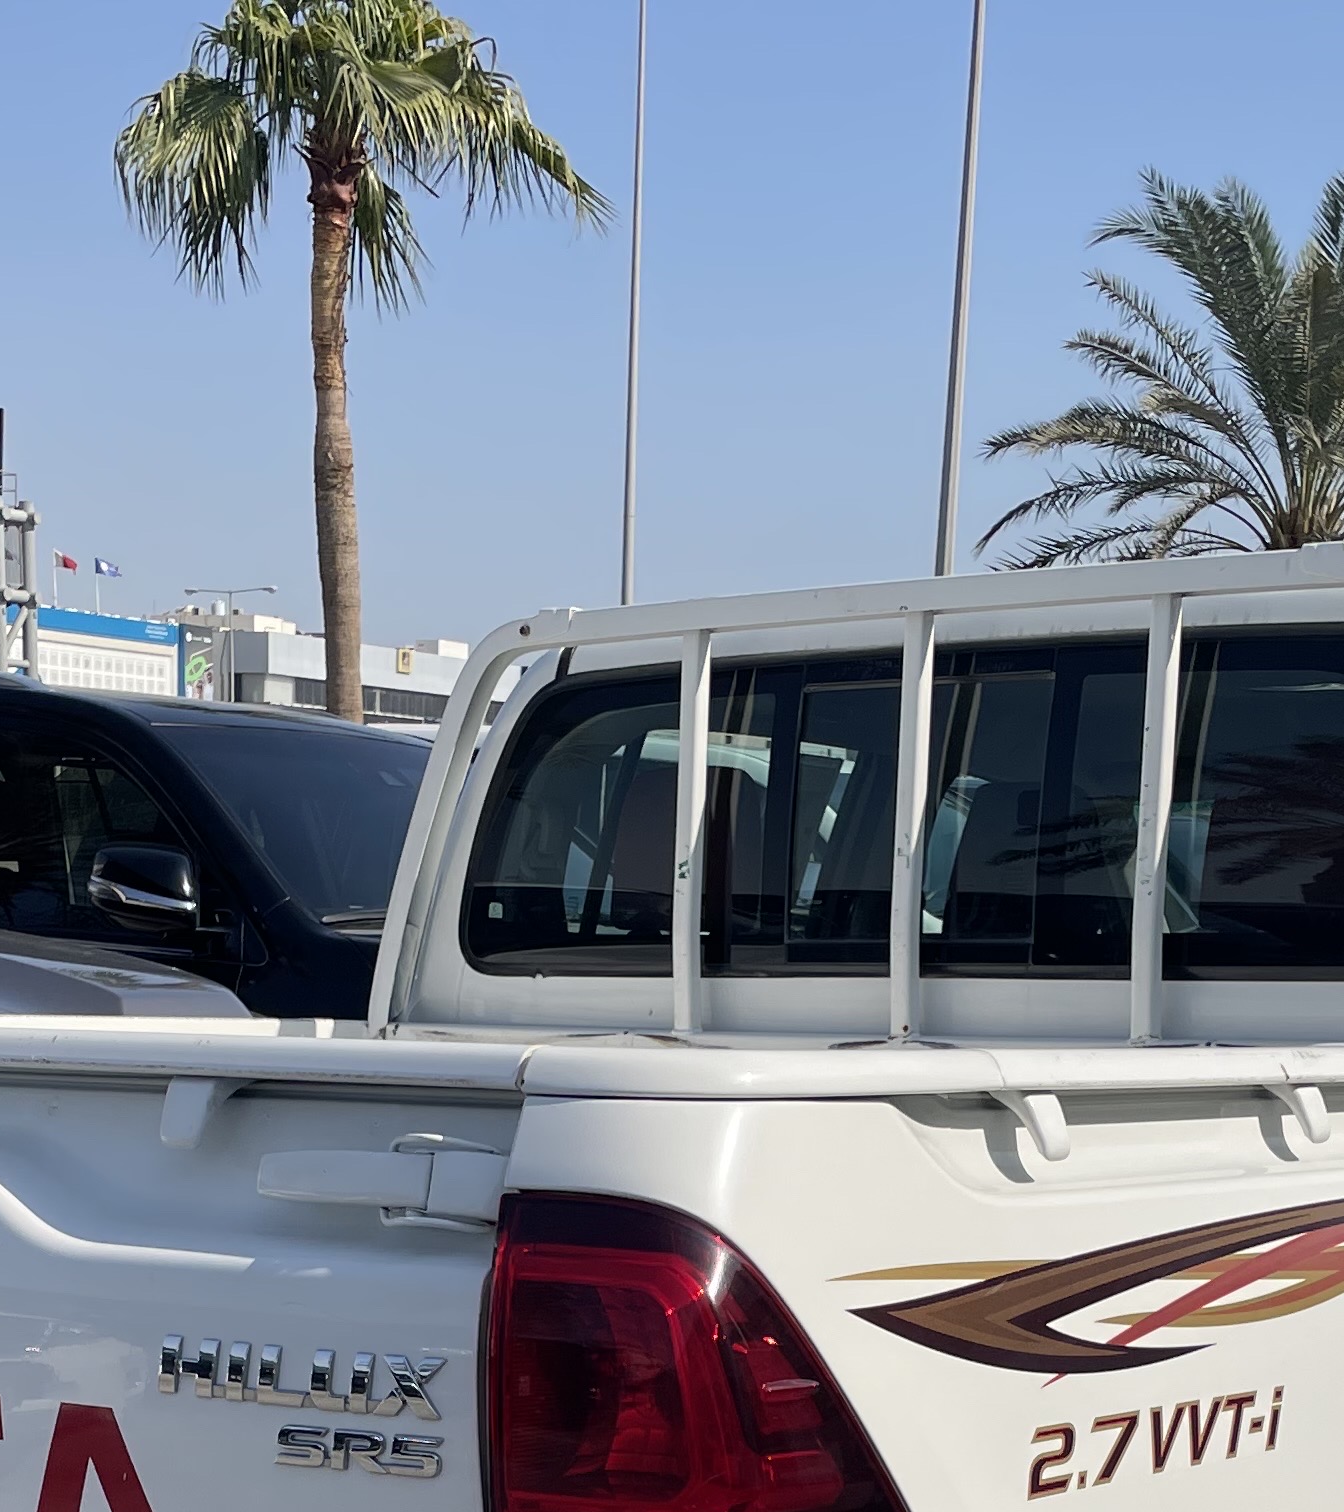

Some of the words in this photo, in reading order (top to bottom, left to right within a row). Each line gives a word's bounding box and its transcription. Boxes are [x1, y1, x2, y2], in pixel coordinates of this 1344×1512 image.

[157, 1334, 448, 1421] HILUX
[272, 1424, 445, 1478] SR5
[1027, 1421, 1141, 1501] 2.7
[1149, 1385, 1285, 1474] VVT-i
